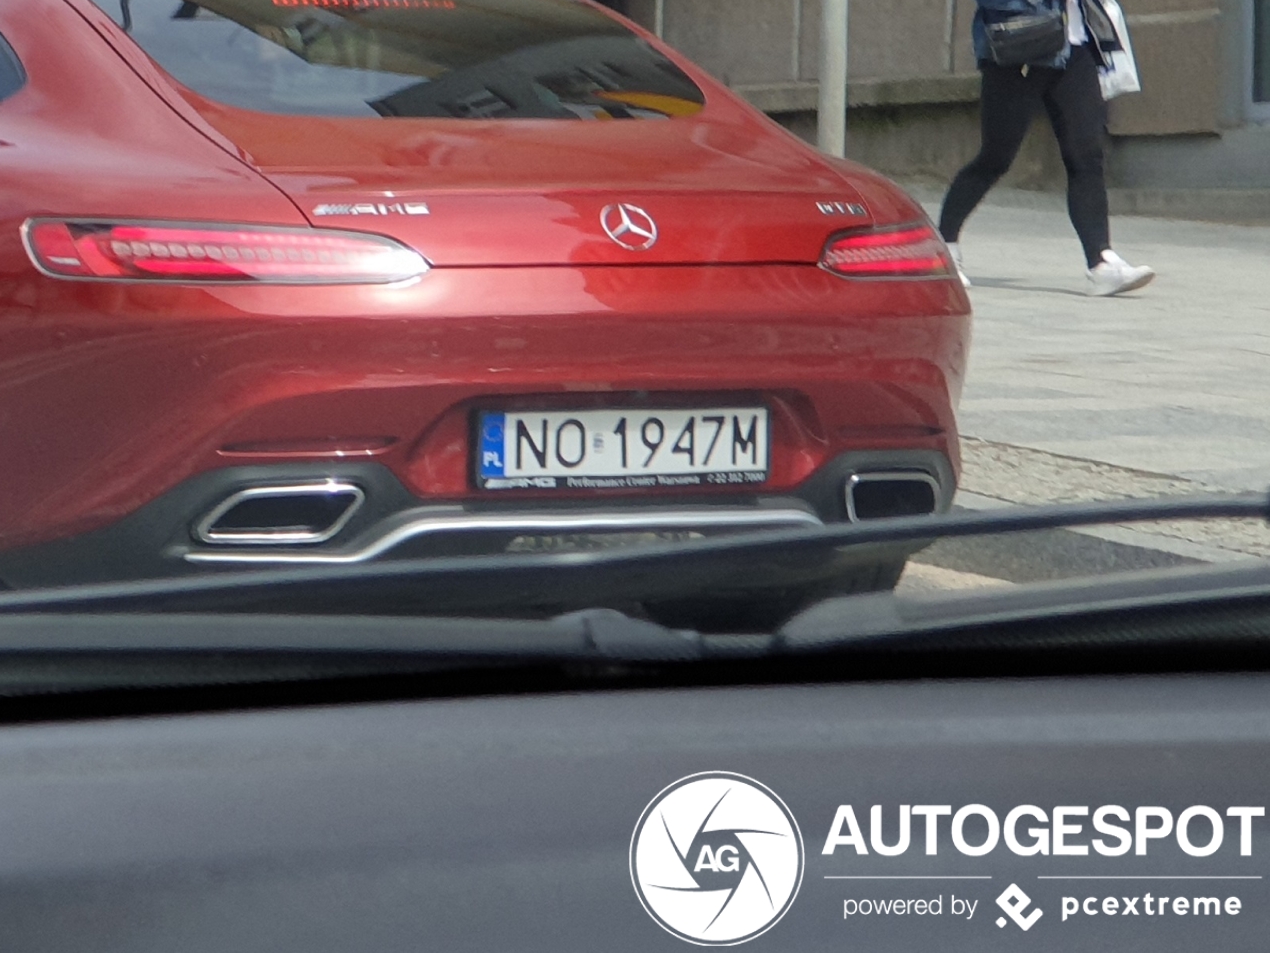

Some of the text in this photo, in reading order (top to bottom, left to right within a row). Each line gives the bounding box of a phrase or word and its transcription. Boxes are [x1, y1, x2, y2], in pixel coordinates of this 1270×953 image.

[482, 414, 758, 470] PL NO 1947M
